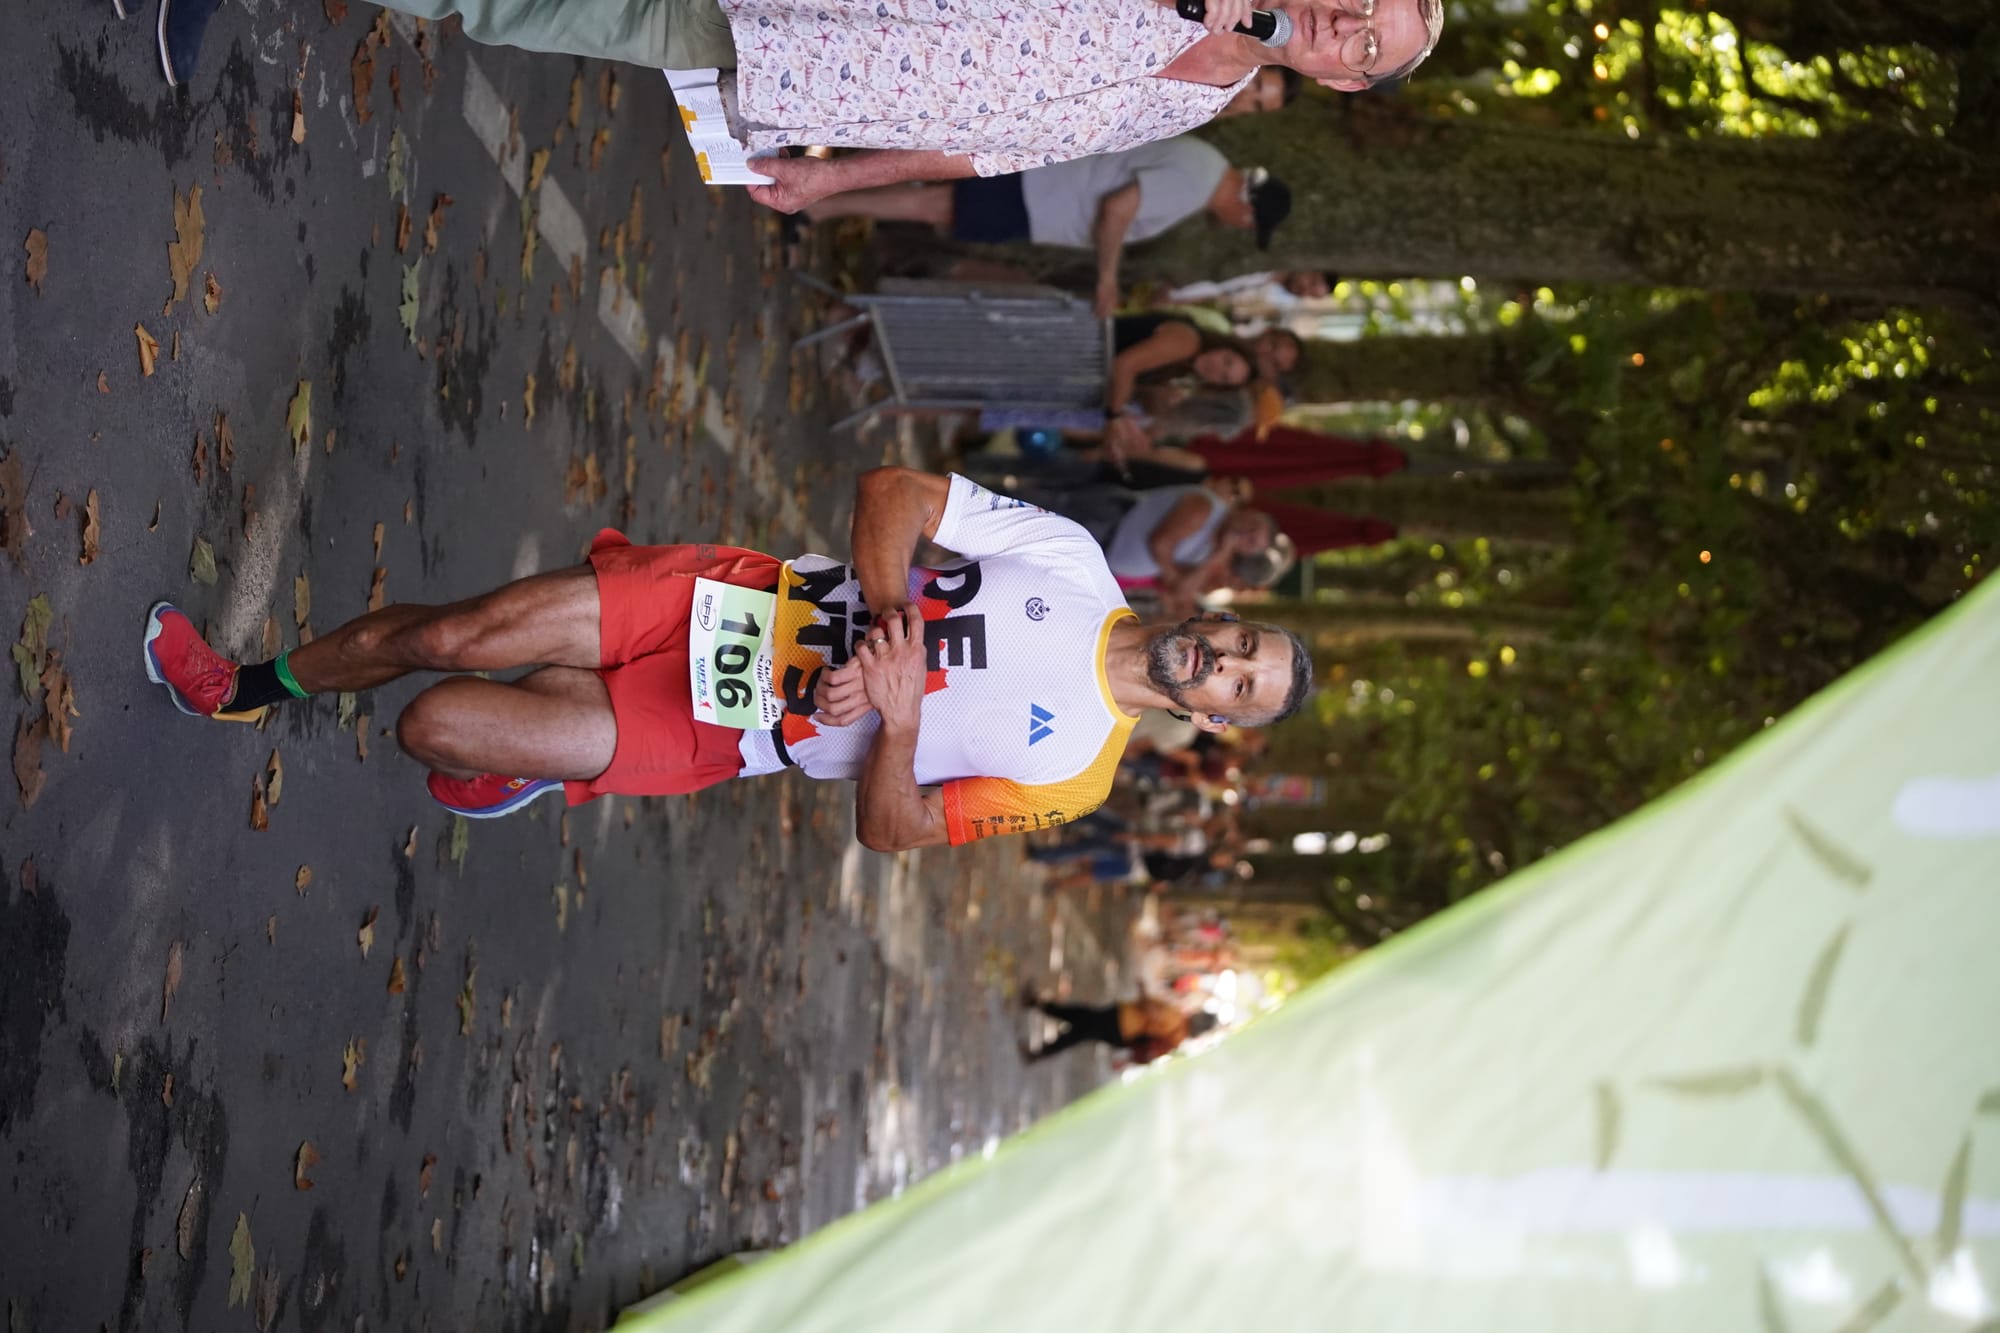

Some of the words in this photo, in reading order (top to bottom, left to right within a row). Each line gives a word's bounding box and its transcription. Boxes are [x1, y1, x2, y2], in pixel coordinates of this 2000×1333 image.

[702, 594, 713, 626] BFP
[699, 656, 707, 696] TUFF'S
[715, 612, 760, 708] 106
[764, 659, 774, 699] Challenge
